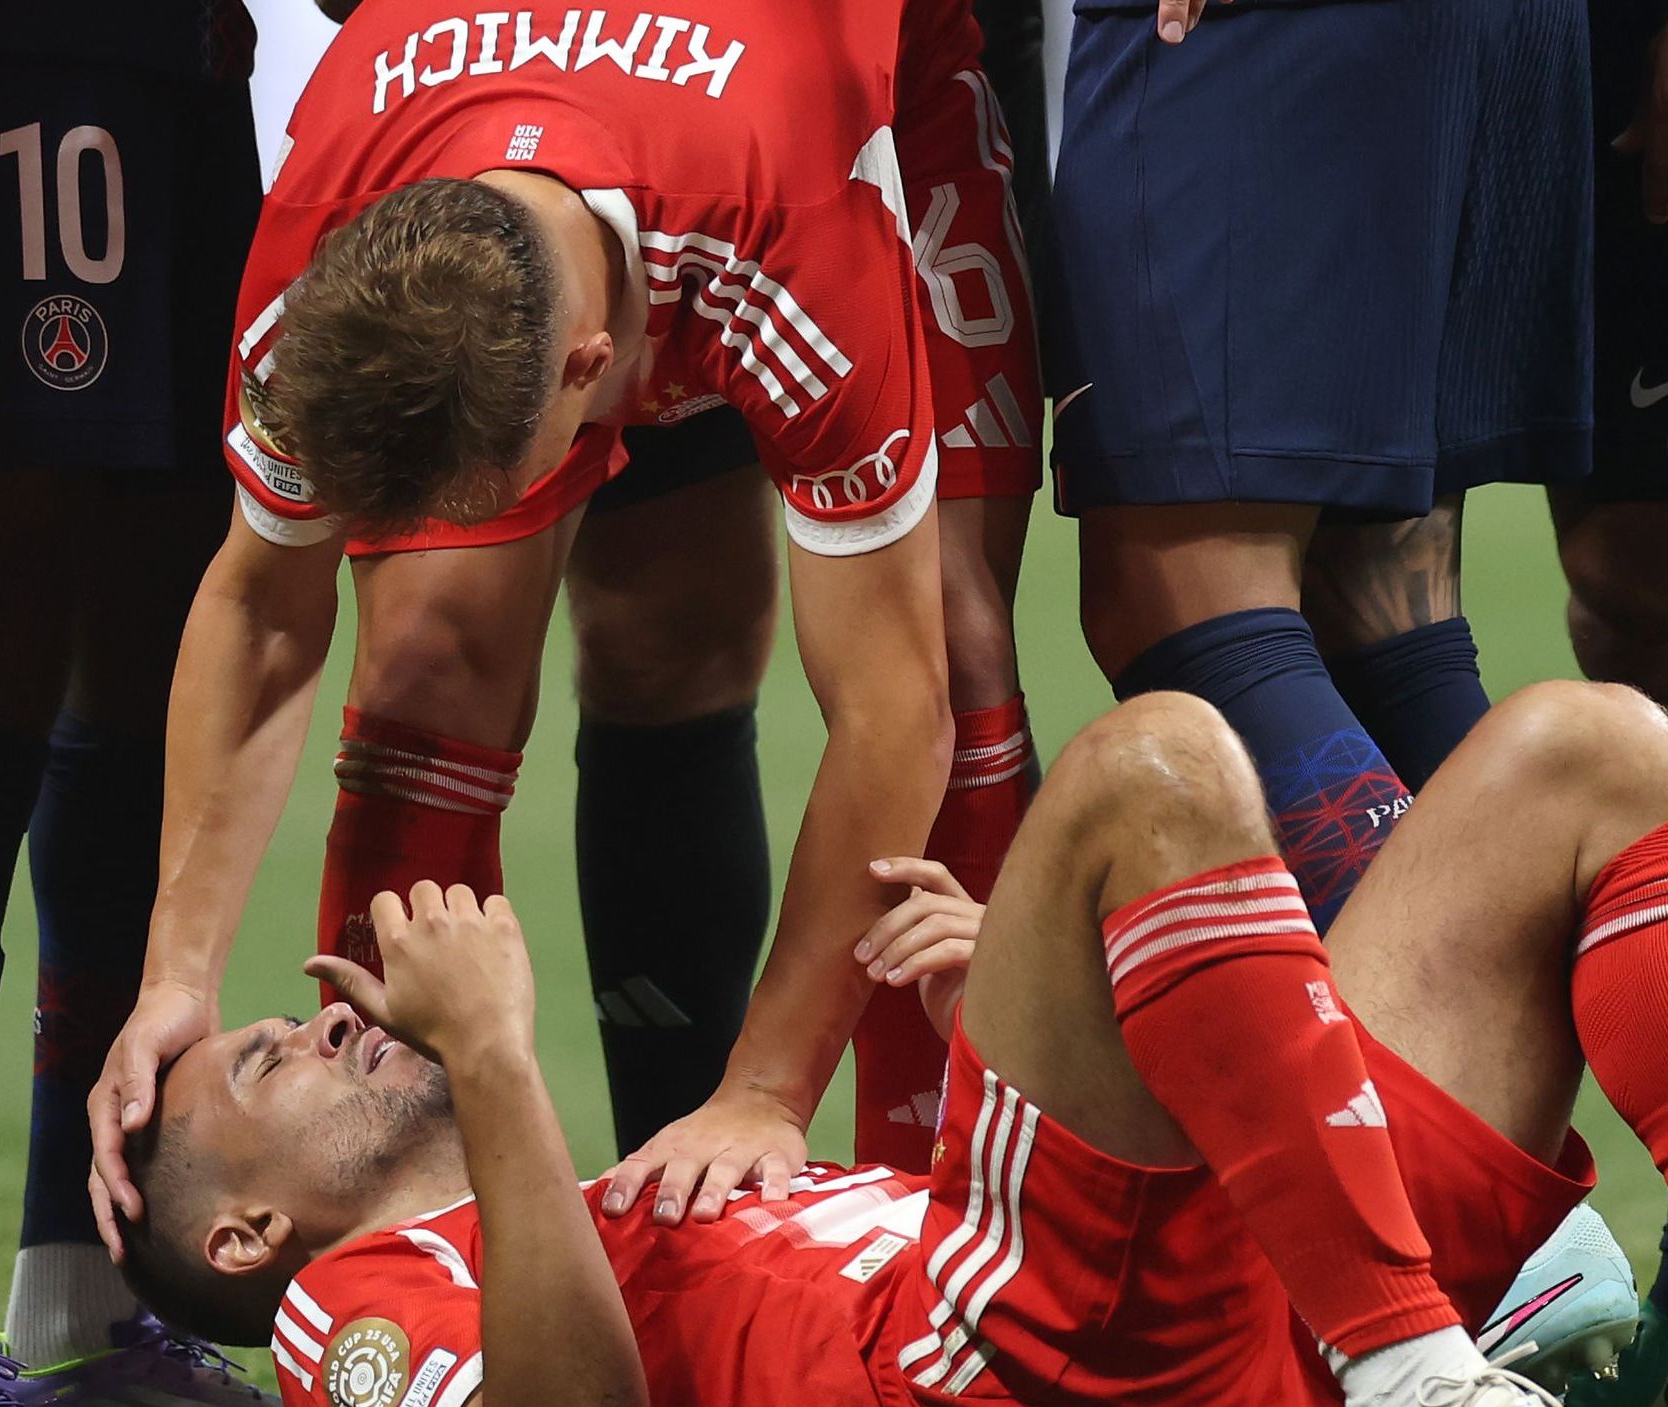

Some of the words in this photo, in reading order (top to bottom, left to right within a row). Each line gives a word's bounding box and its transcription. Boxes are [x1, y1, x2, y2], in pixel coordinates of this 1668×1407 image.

[372, 9, 746, 115] KIMMICH
[514, 123, 544, 138] MIA
[509, 135, 540, 150] SAN
[505, 147, 536, 161] MIA
[913, 182, 1015, 349] 6
[34, 299, 93, 323] PARIS
[268, 460, 302, 481] UNITES
[275, 477, 301, 494] FIFA
[337, 1331, 362, 1357] CUP
[364, 1328, 382, 1341] 25
[380, 1334, 401, 1363] USA
[412, 1359, 438, 1395] UNITES
